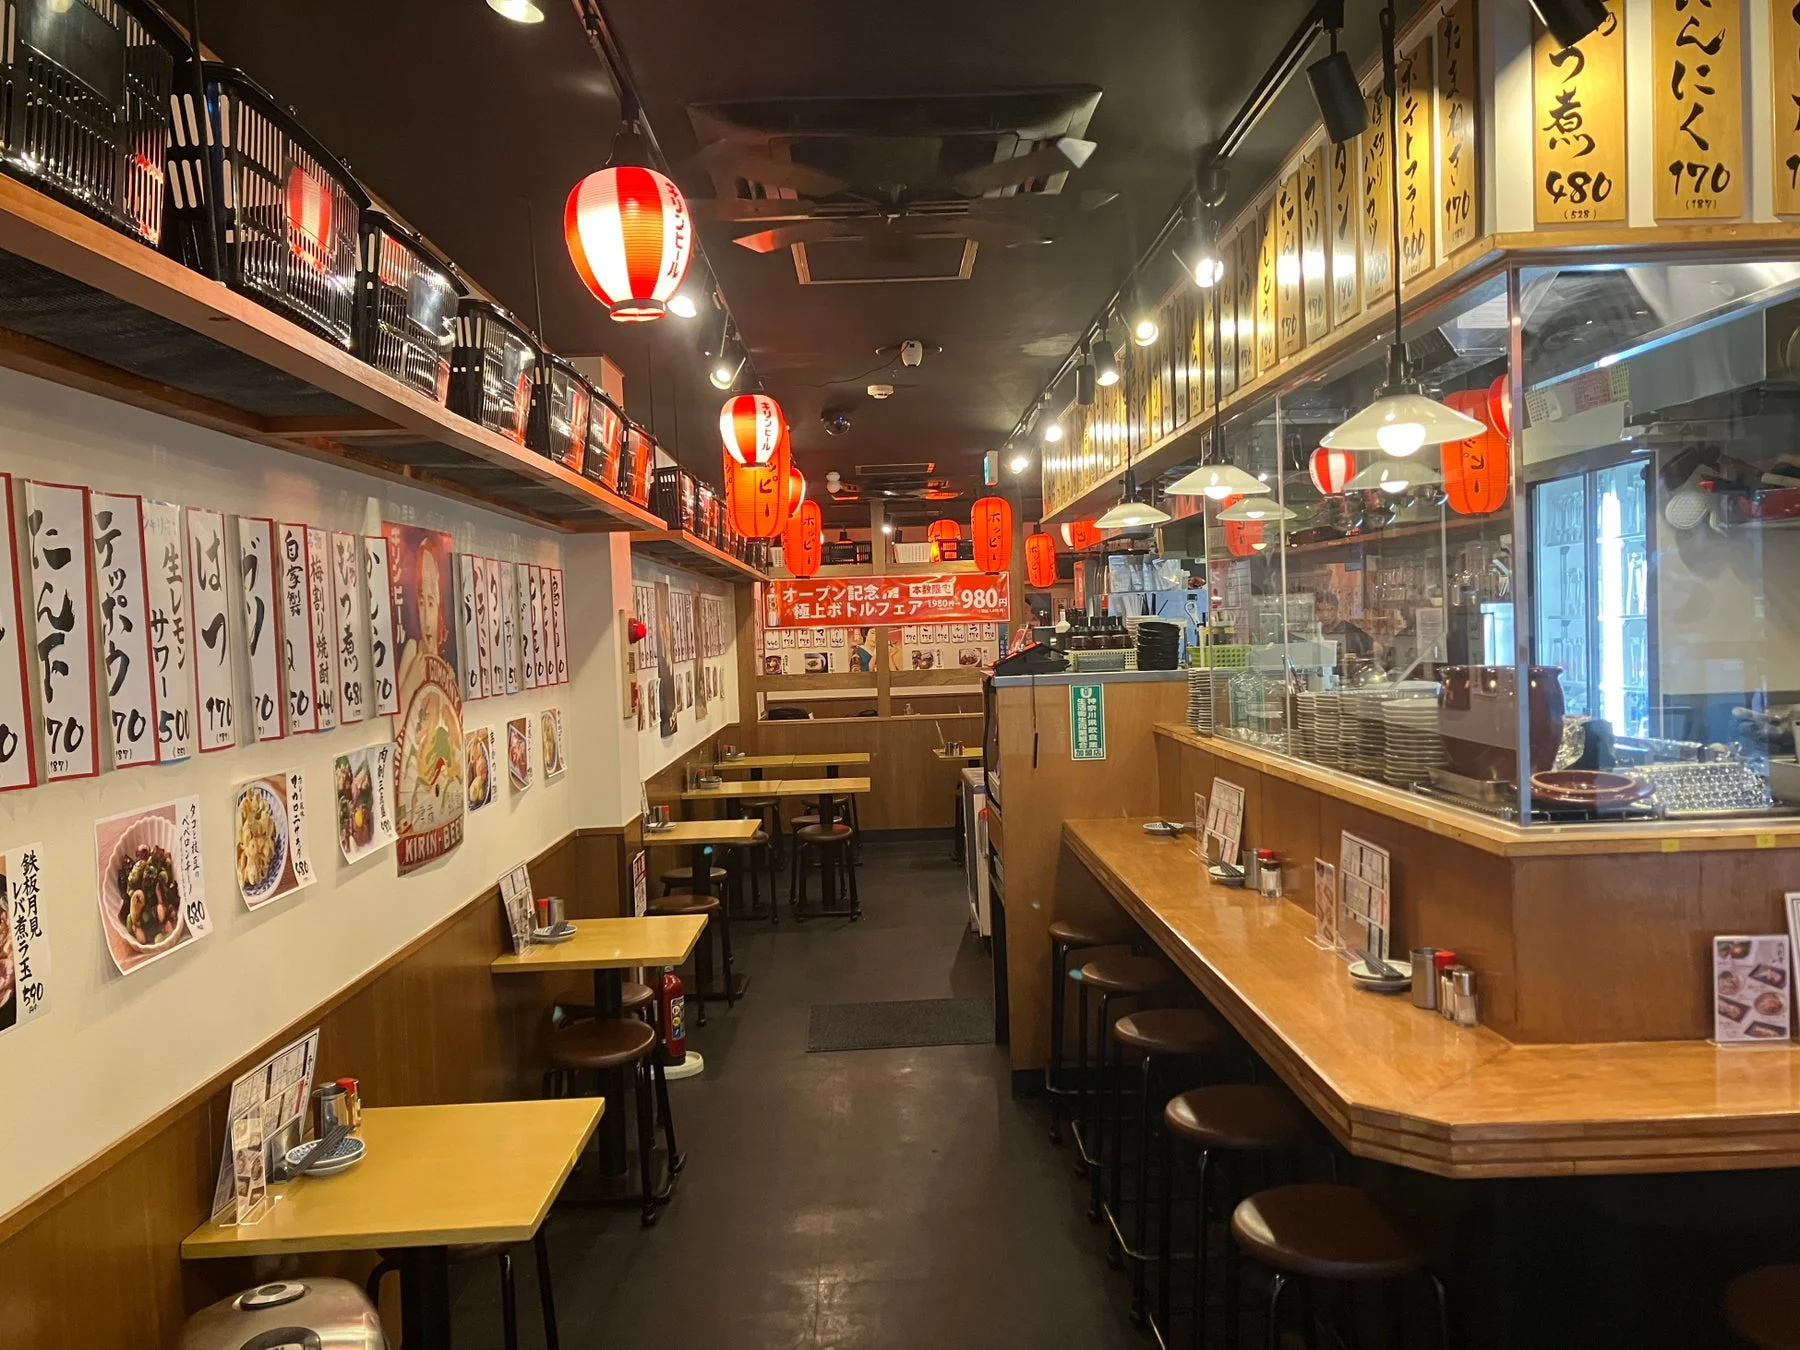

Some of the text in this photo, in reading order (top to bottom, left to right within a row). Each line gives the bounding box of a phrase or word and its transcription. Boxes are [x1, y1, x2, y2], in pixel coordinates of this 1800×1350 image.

[1672, 0, 1726, 151] んにく
[1542, 45, 1596, 158] つ煮
[1401, 55, 1419, 228] ポテトフライ
[1545, 171, 1613, 204] 480
[1669, 159, 1731, 196] 170
[1445, 189, 1470, 231] 170
[1563, 210, 1597, 220] (528)
[1685, 198, 1717, 210] (187)
[1402, 228, 1426, 265] 400
[759, 461, 779, 518] ッピー
[803, 516, 816, 565] ホッピー
[988, 512, 1002, 561] ホッピー
[284, 530, 304, 617] 自家製
[782, 583, 880, 603] オープン記念
[911, 584, 952, 595] 本数限定
[93, 510, 133, 697] テッポウ
[162, 542, 185, 671] 生レモン
[195, 528, 227, 667] はつ
[793, 600, 924, 620] 極上ボトルフェア
[961, 588, 1008, 609] 980円
[310, 554, 330, 685] 梅割り焼酎
[150, 608, 169, 698] サワー
[44, 715, 84, 755] 70
[111, 708, 147, 744] 70
[206, 696, 233, 736] 170
[404, 834, 439, 862] KIRIN
[20, 849, 43, 941] 鉄板月見
[186, 900, 206, 925] 680
[12, 881, 33, 983] レバ煮ラ玉
[22, 982, 44, 1007] 590
